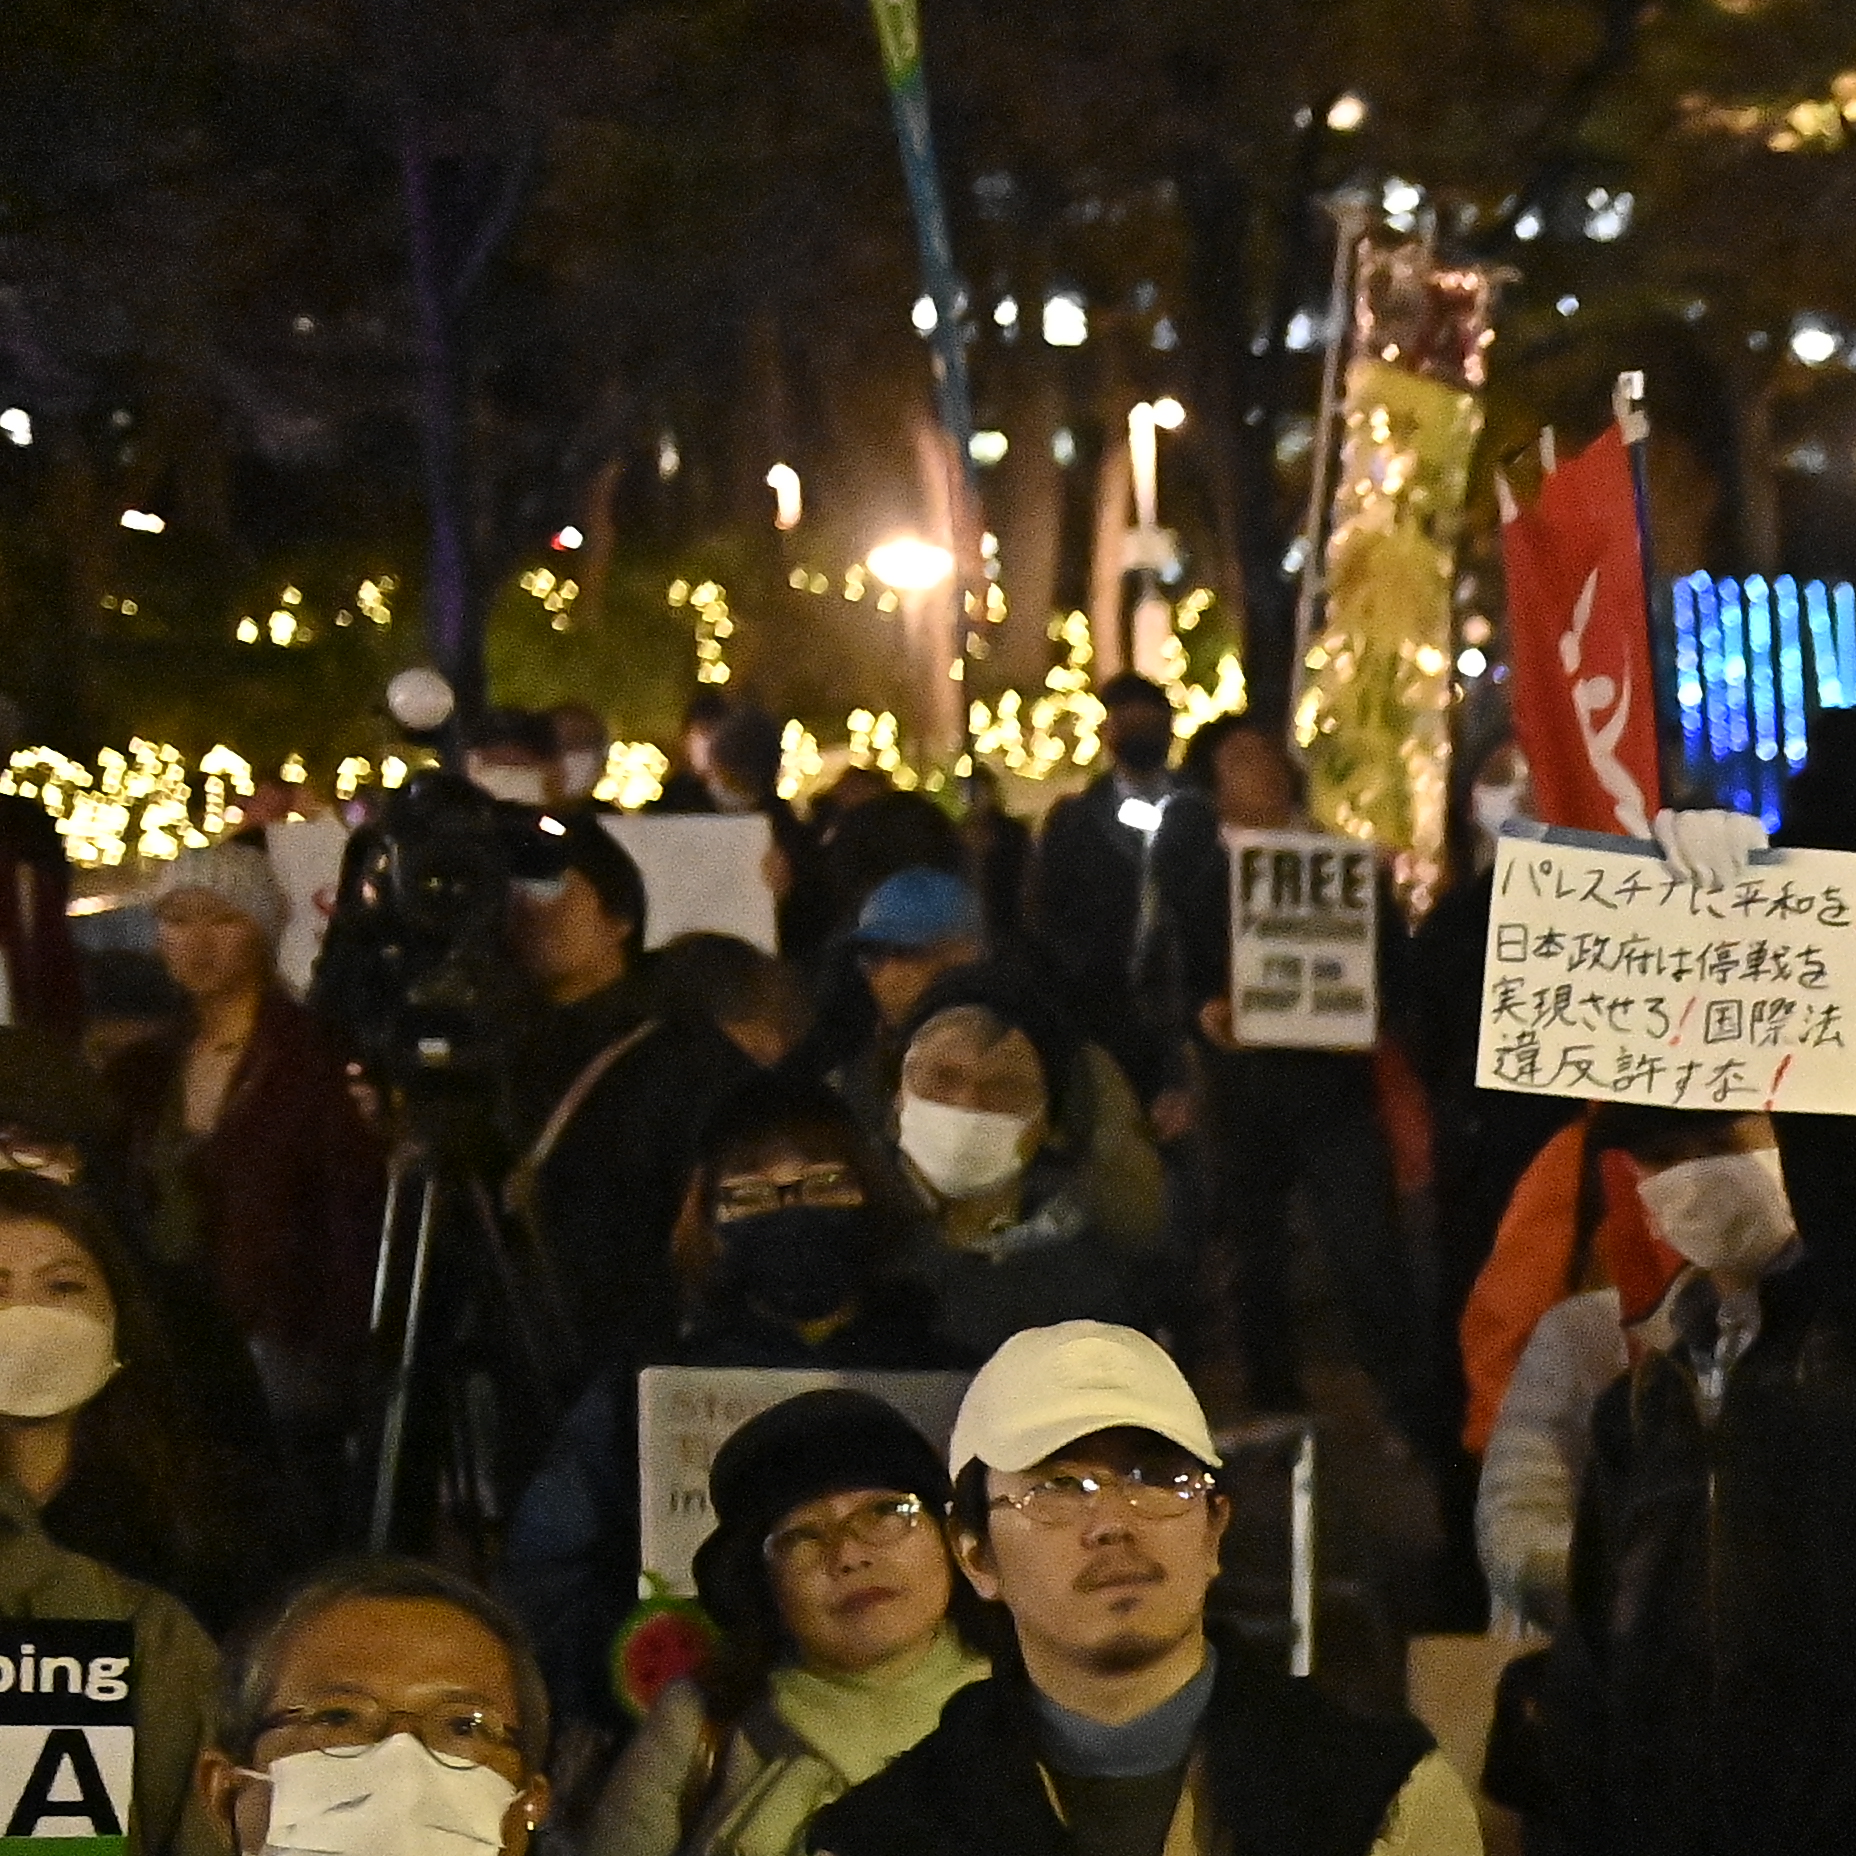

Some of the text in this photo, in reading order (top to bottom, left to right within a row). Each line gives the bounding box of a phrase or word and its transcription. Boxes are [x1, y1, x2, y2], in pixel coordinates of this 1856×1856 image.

[1497, 922, 1830, 991] 日本政府は停戦を
[1703, 998, 1847, 1049] 国際法
[1492, 1030, 1793, 1112] 違反許すな！
